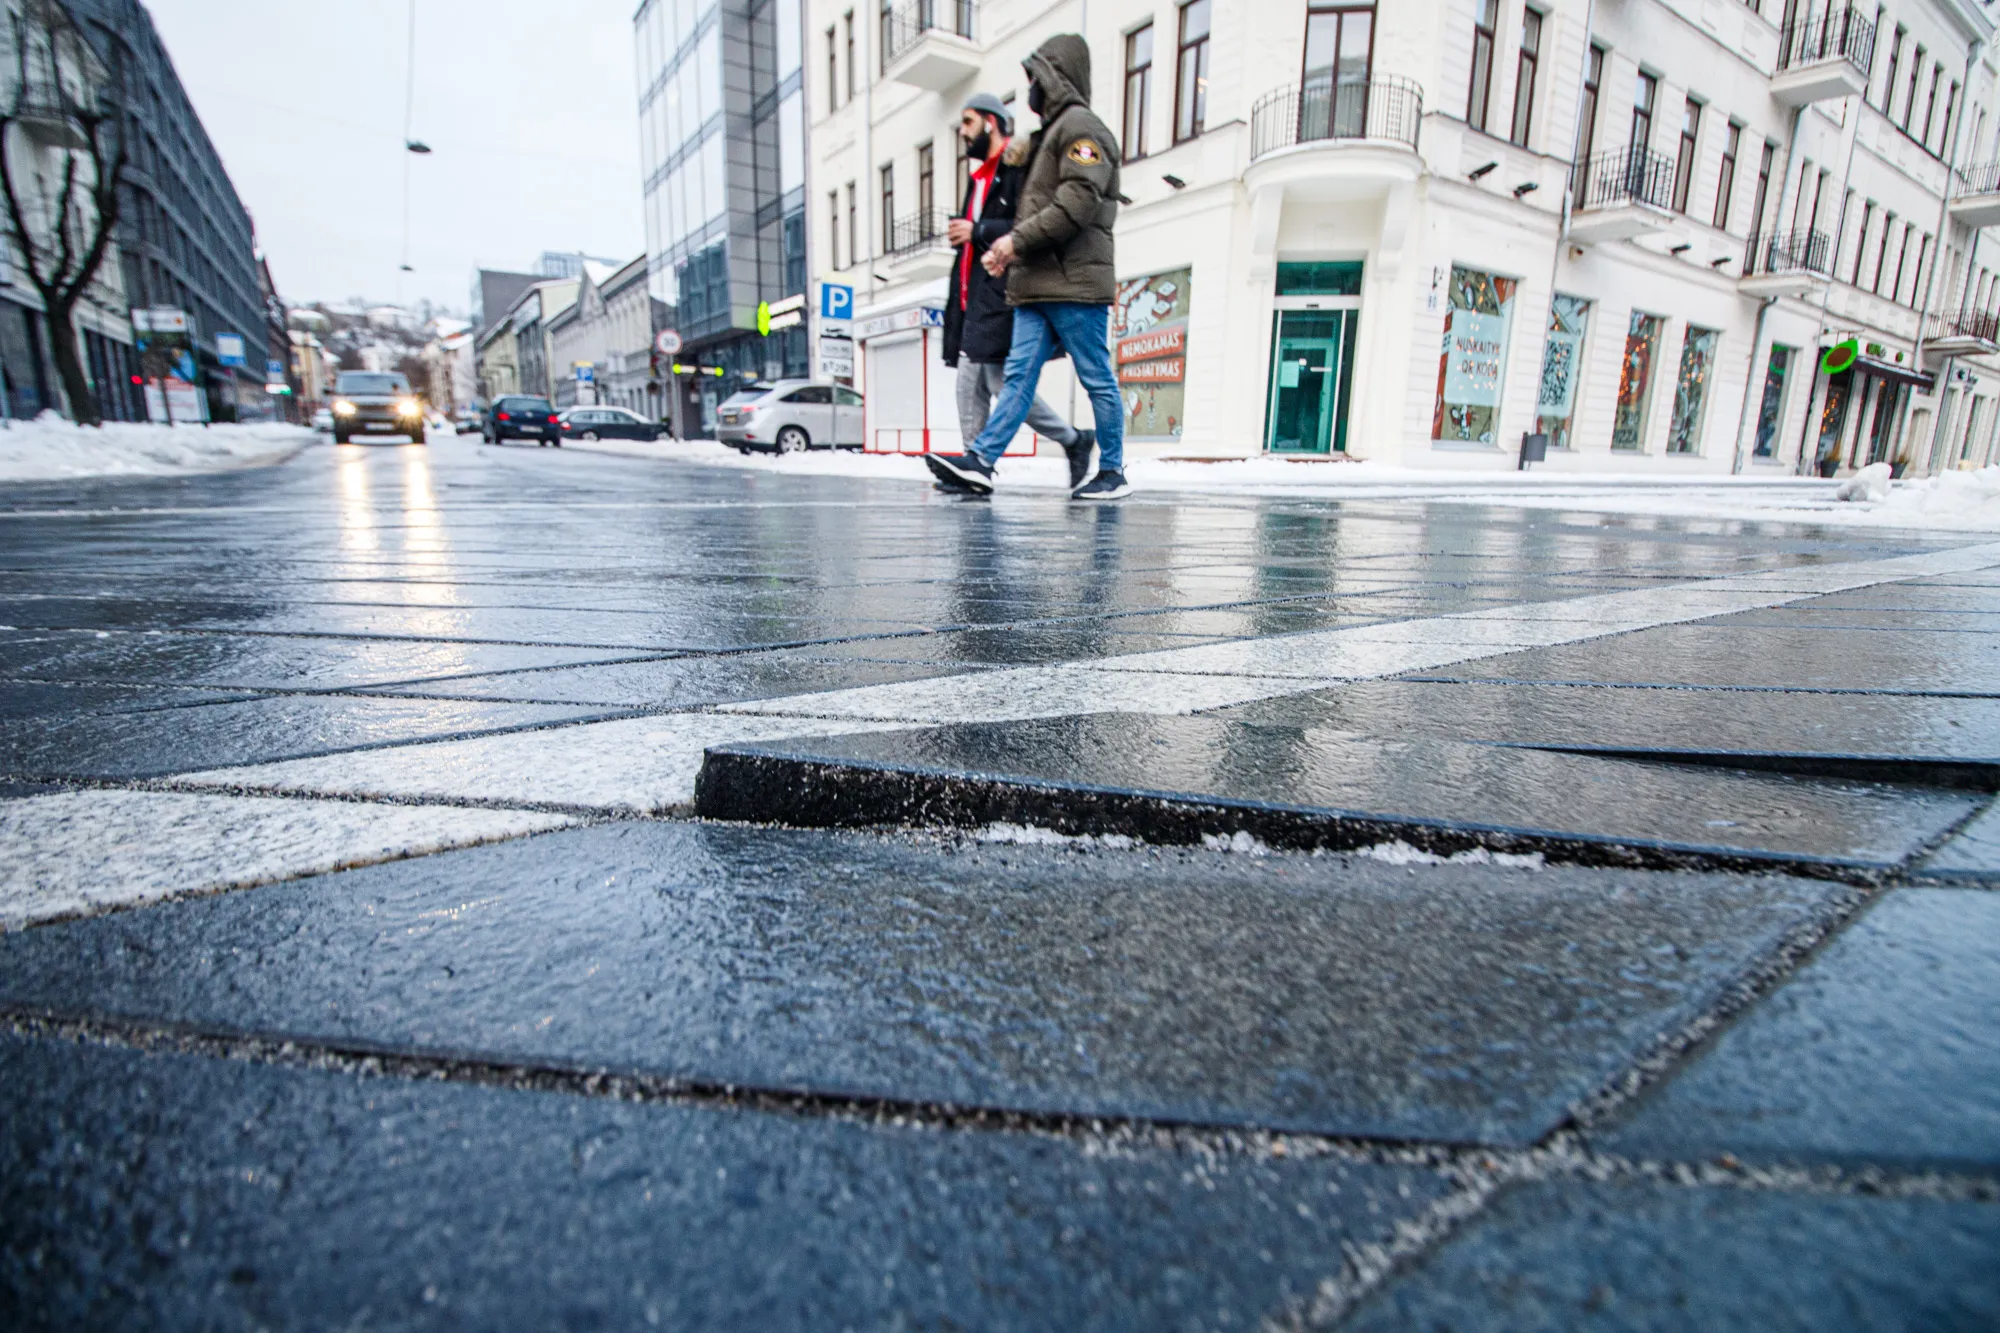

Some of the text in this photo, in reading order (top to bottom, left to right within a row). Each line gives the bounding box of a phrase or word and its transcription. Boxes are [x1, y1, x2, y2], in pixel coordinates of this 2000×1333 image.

[828, 287, 849, 316] P
[1121, 332, 1179, 358] NEMOKAMAS
[1461, 359, 1475, 375] QR
